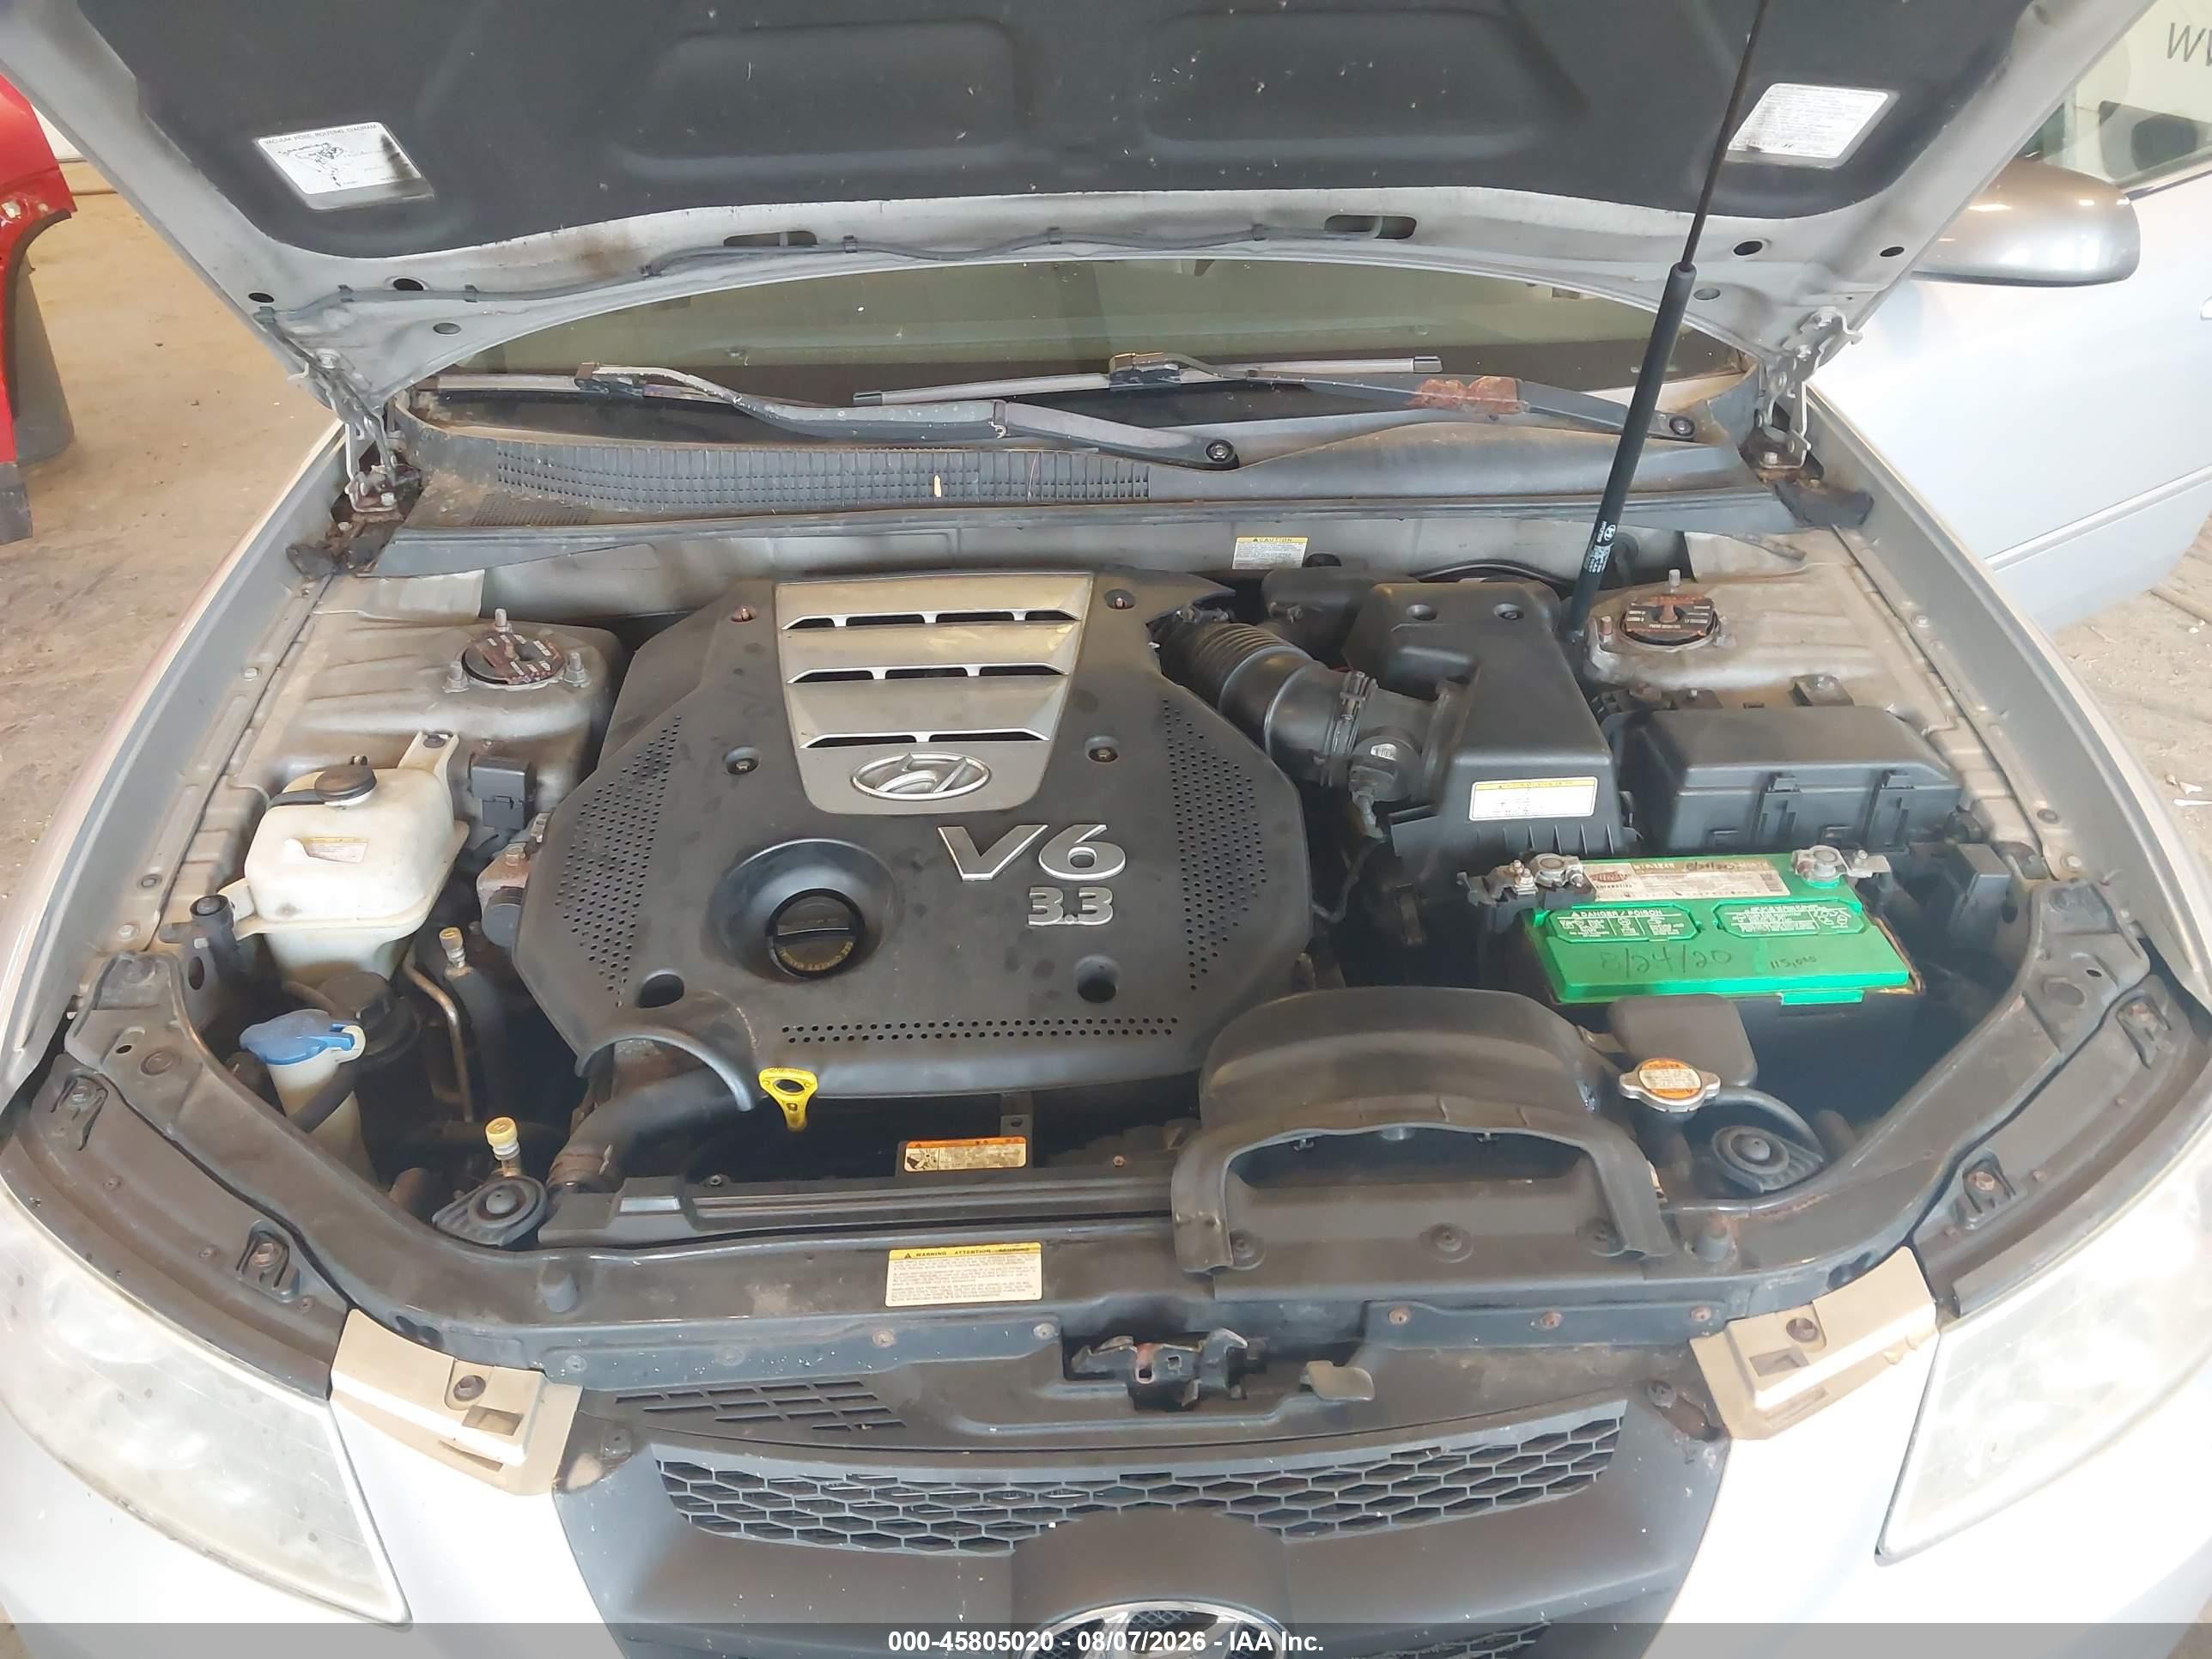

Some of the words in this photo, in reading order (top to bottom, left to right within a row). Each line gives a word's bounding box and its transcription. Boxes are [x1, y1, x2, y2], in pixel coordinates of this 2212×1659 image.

[2166, 21, 2212, 66] W
[937, 823, 1127, 881] V6
[1028, 886, 1114, 926] 3.3
[1580, 909, 1618, 918] DANGER
[1600, 945, 1732, 977] 8/24/20
